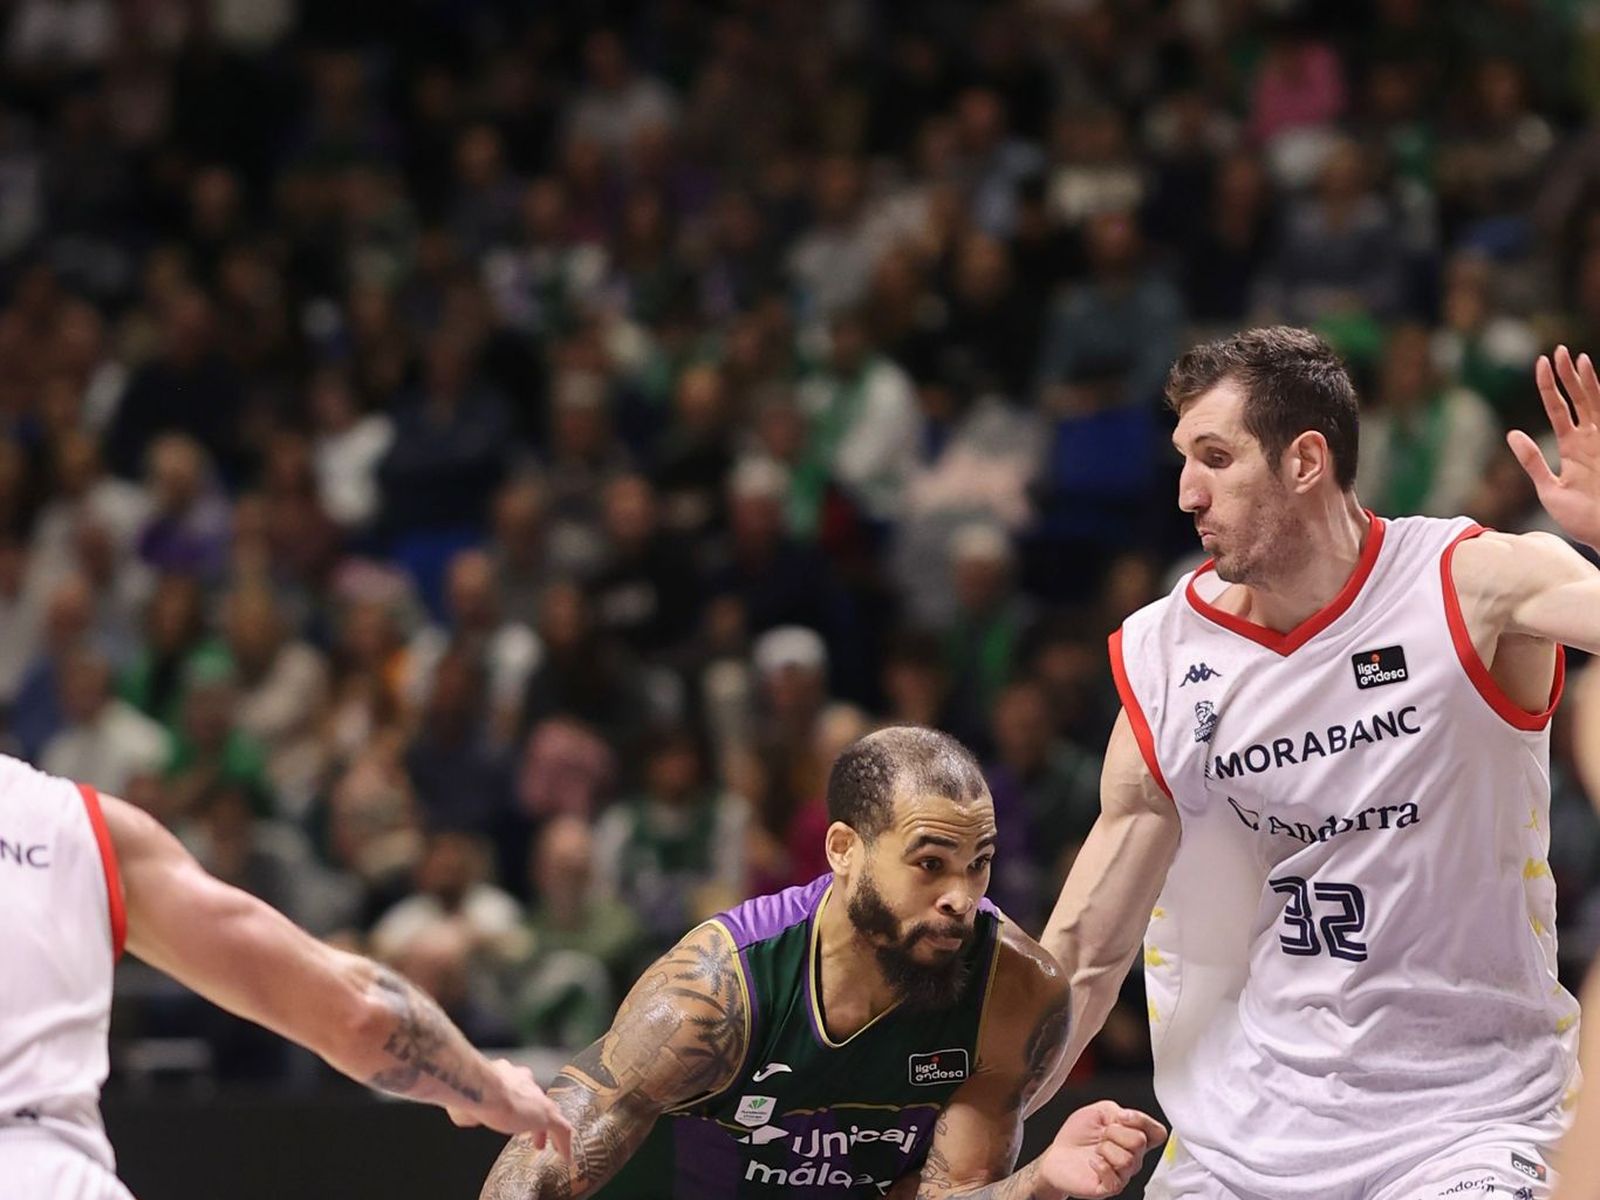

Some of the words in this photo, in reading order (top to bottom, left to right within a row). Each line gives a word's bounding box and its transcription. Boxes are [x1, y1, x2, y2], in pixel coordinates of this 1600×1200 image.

[1357, 662, 1380, 677] liga
[1360, 667, 1407, 687] endesa
[1215, 705, 1421, 779] MORABANC
[1269, 875, 1368, 963] 32
[915, 1061, 937, 1076] liga
[915, 1068, 964, 1082] endesa
[792, 1125, 918, 1158] Unicaj
[1513, 1160, 1538, 1178] acb
